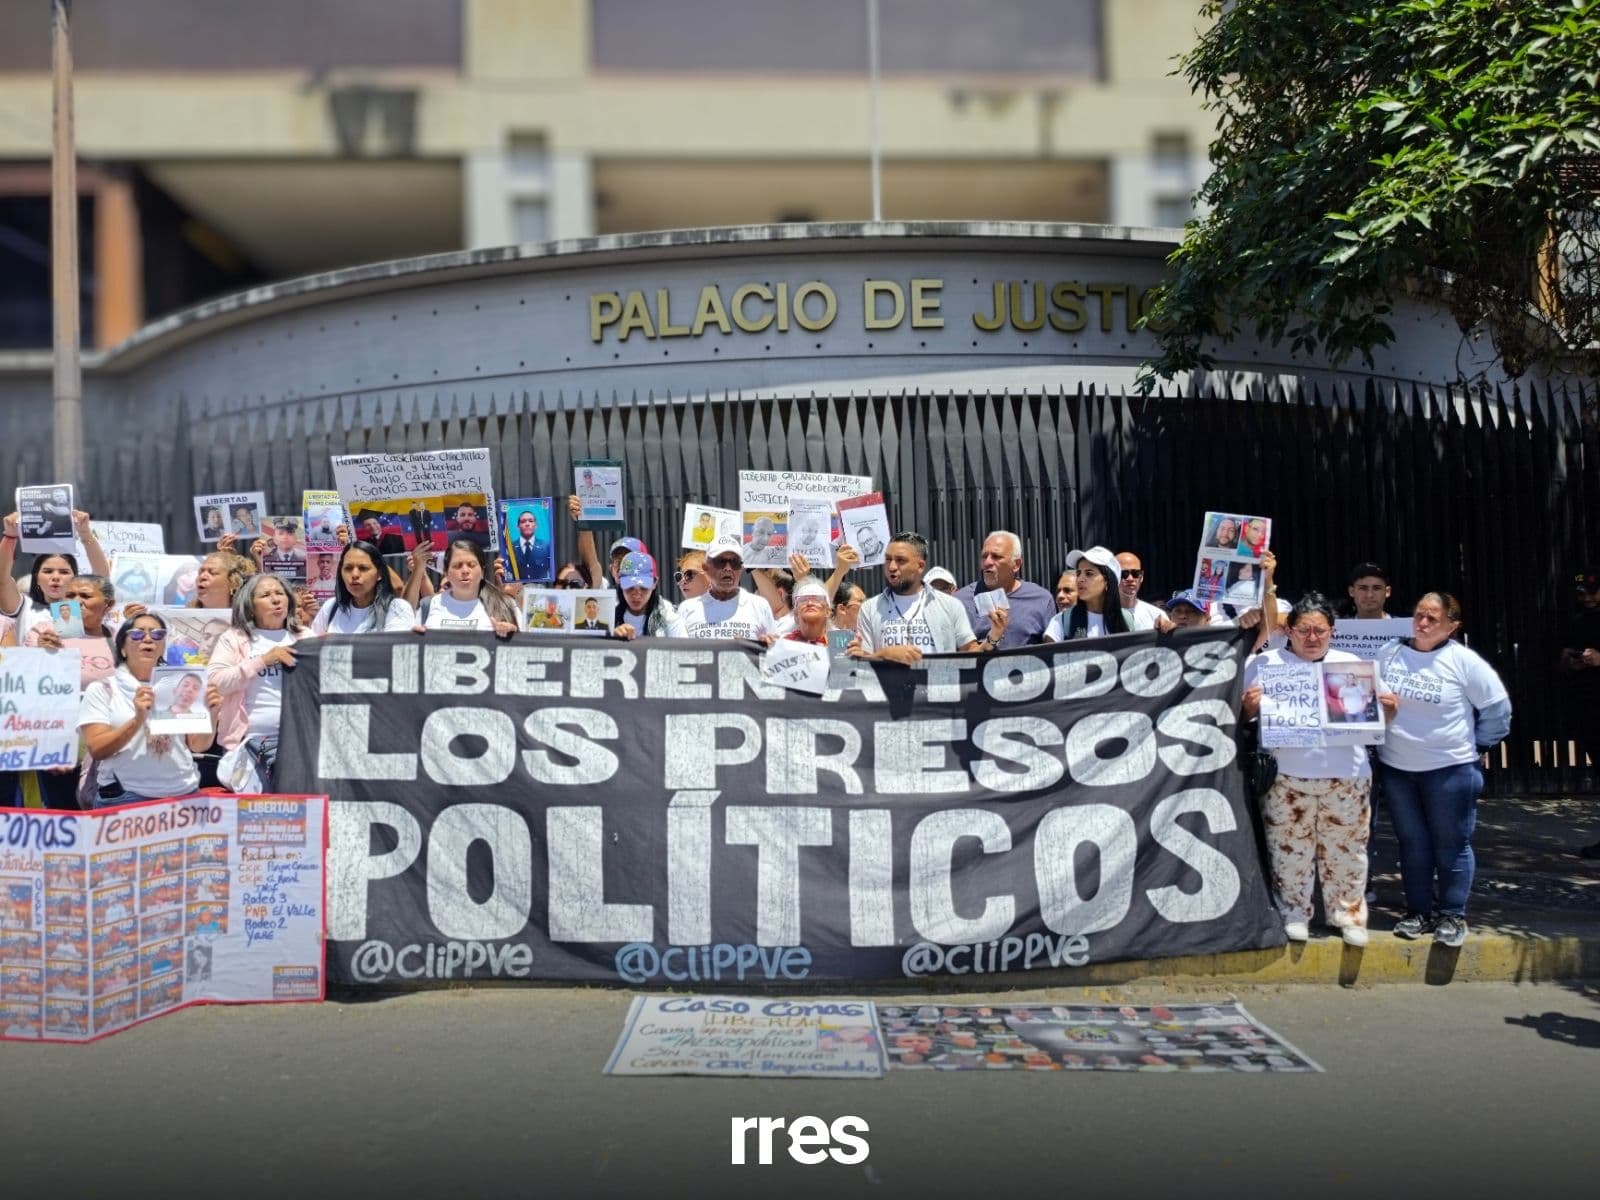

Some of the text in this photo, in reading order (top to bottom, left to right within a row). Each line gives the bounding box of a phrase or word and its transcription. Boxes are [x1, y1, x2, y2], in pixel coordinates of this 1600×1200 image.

[589, 278, 1232, 343] PALACIO DE JUSTIC
[360, 462, 464, 475] Justicia y Libertad
[369, 471, 456, 485] Abajo Cadenas
[781, 472, 823, 482] ORLANDO
[777, 482, 802, 491] CASO
[206, 495, 248, 505] LIBERTAD
[743, 490, 791, 505] JUSTICIA
[714, 629, 751, 638] PRESOS
[900, 626, 931, 635] PRESO
[319, 643, 786, 700] LIBEREN
[914, 640, 1238, 703] TODOS
[38, 675, 74, 696] Que
[1402, 677, 1443, 693] PRESOS
[318, 698, 1237, 794] LOS PRESOS
[248, 800, 298, 814] LIBERTAD
[325, 788, 1241, 948] POLÍTICOS
[242, 891, 287, 905] Rodeo 3
[244, 916, 288, 931] Rodeo 2
[658, 997, 865, 1017] Caso Conas
